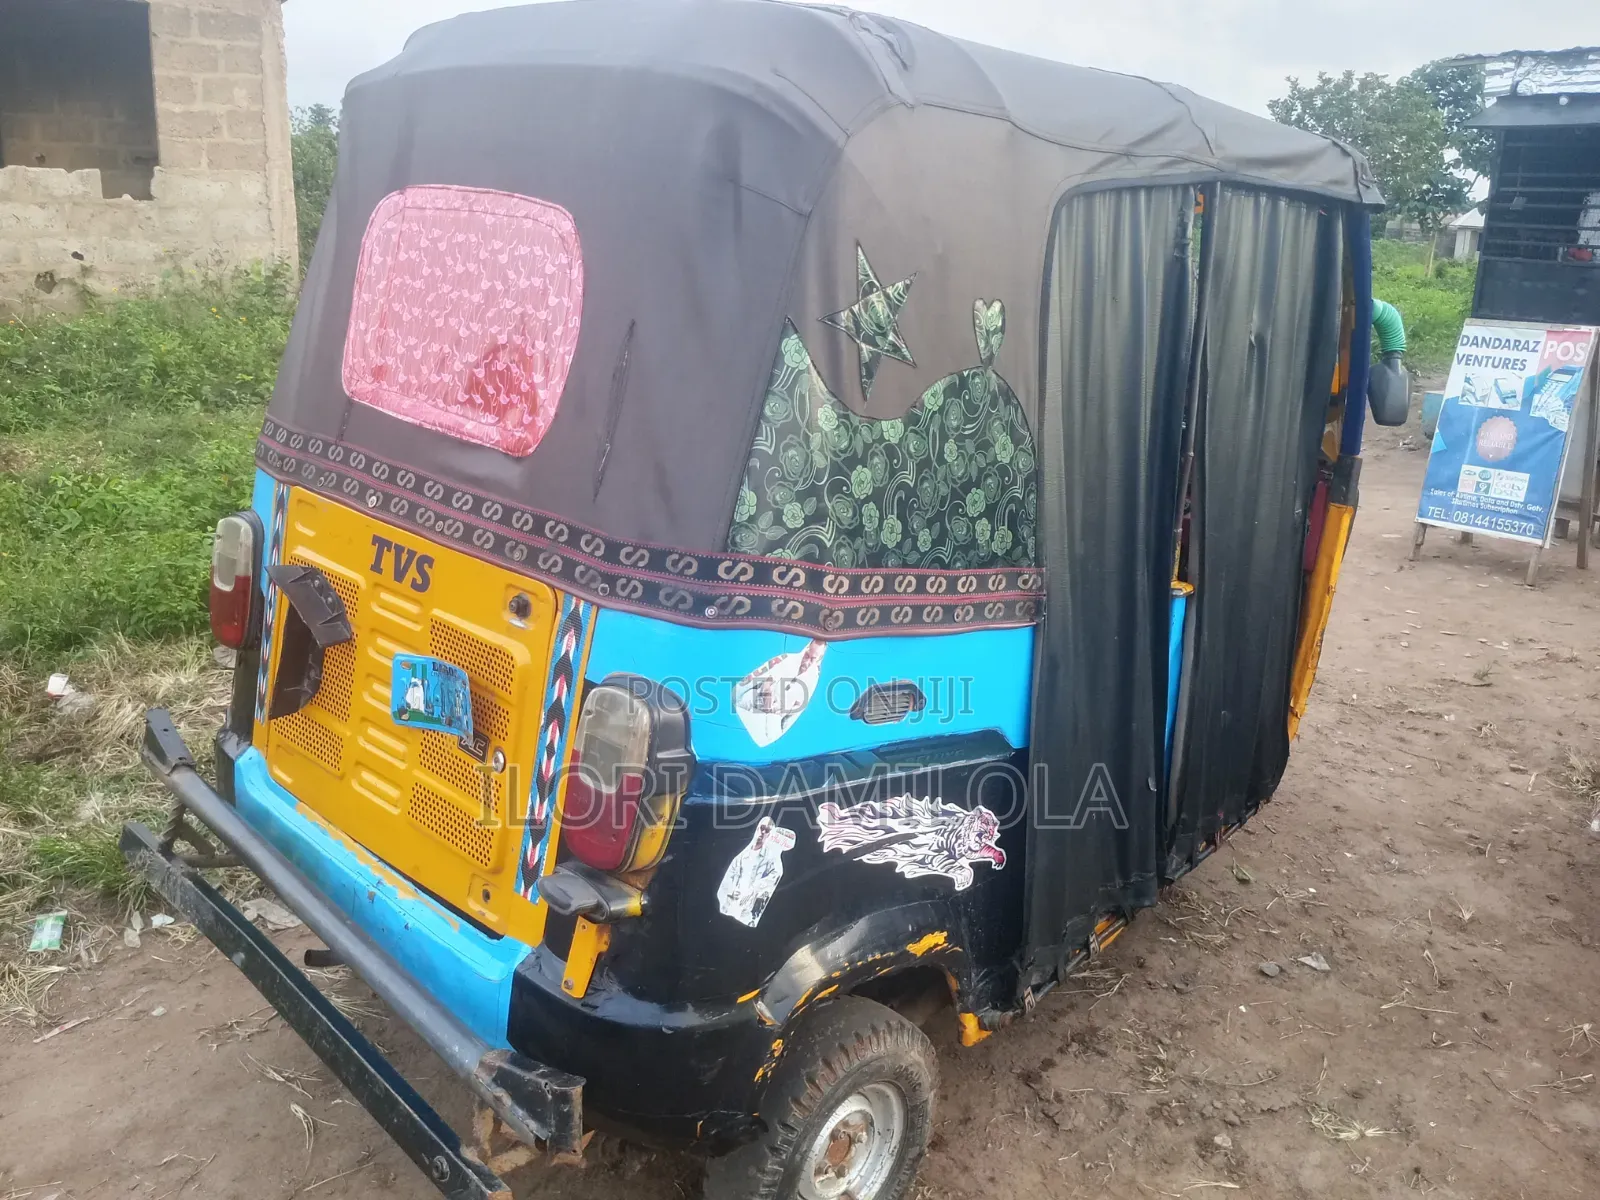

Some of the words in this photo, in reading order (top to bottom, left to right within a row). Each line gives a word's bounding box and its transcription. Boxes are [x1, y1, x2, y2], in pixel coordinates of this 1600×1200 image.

[1460, 335, 1542, 353] DANDARAZ
[1544, 340, 1588, 362] POS
[1456, 353, 1528, 371] VENTURES
[1496, 497, 1510, 507] and
[1427, 506, 1450, 520] TEL:
[1453, 510, 1535, 536] 08144155370
[370, 534, 434, 592] TVS
